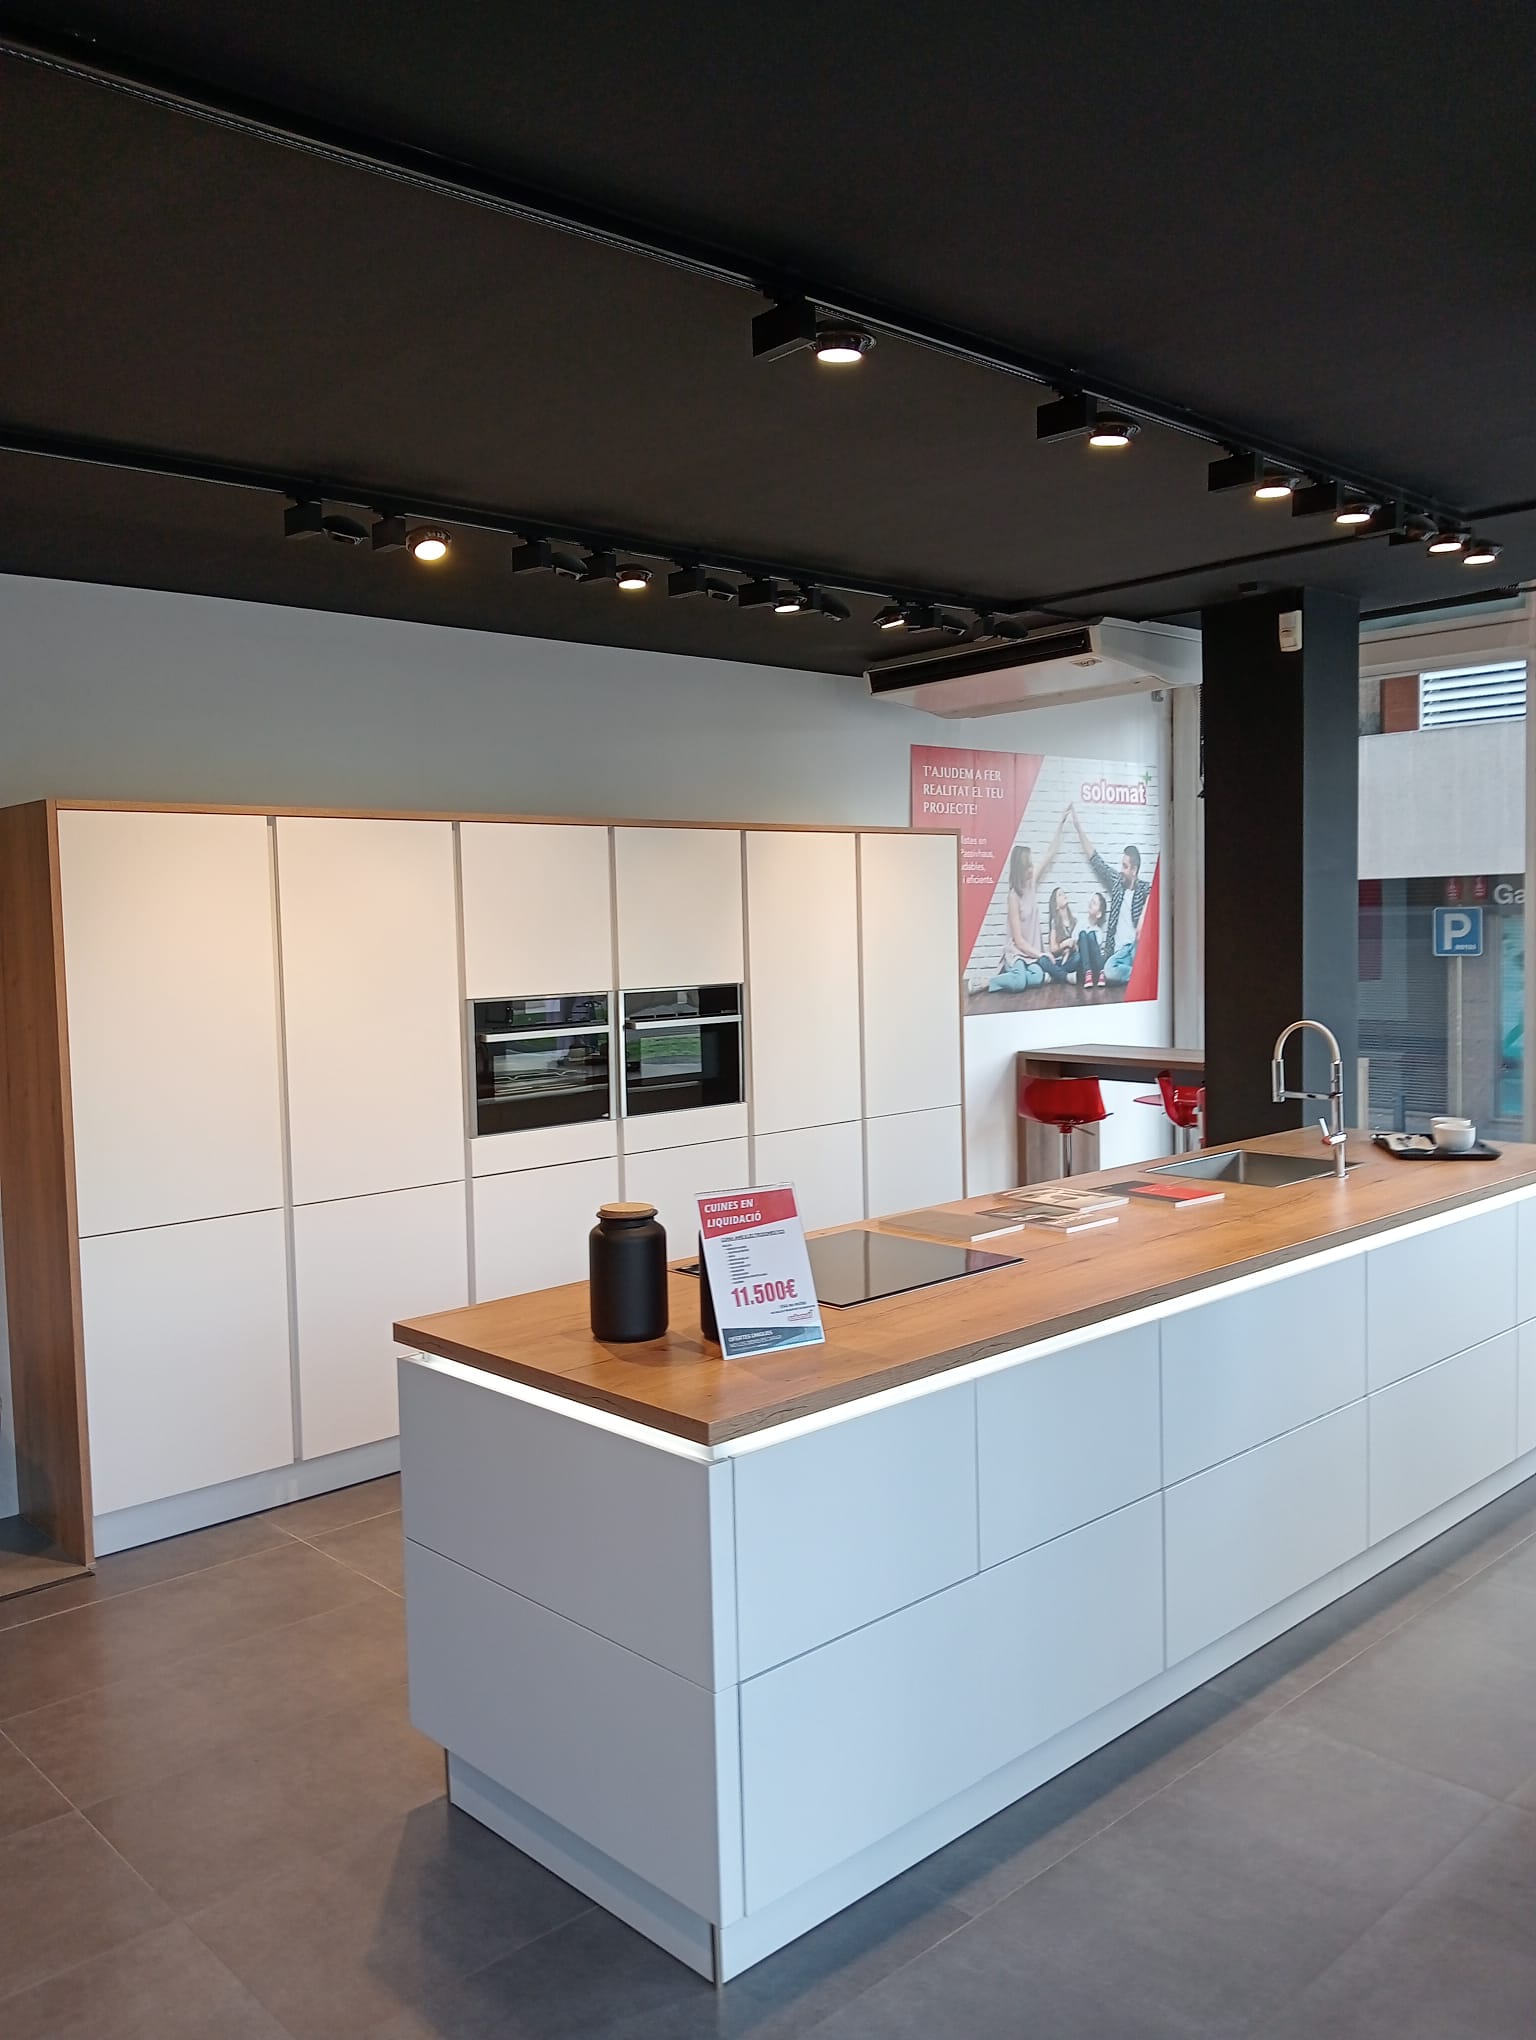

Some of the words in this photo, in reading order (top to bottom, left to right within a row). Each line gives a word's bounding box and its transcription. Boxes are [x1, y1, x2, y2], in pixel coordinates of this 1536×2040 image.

[975, 769, 982, 781] A
[984, 770, 1001, 781] FER
[923, 783, 970, 797] REALITAT
[972, 786, 983, 798] EL
[985, 787, 1004, 799] TEU
[1081, 779, 1146, 805] solomat
[1443, 912, 1472, 951] P
[704, 1200, 739, 1213] CUINES
[740, 1199, 754, 1209] EN
[707, 1210, 762, 1228] LIQUIDACIÓ
[731, 1278, 798, 1308] 11.500€
